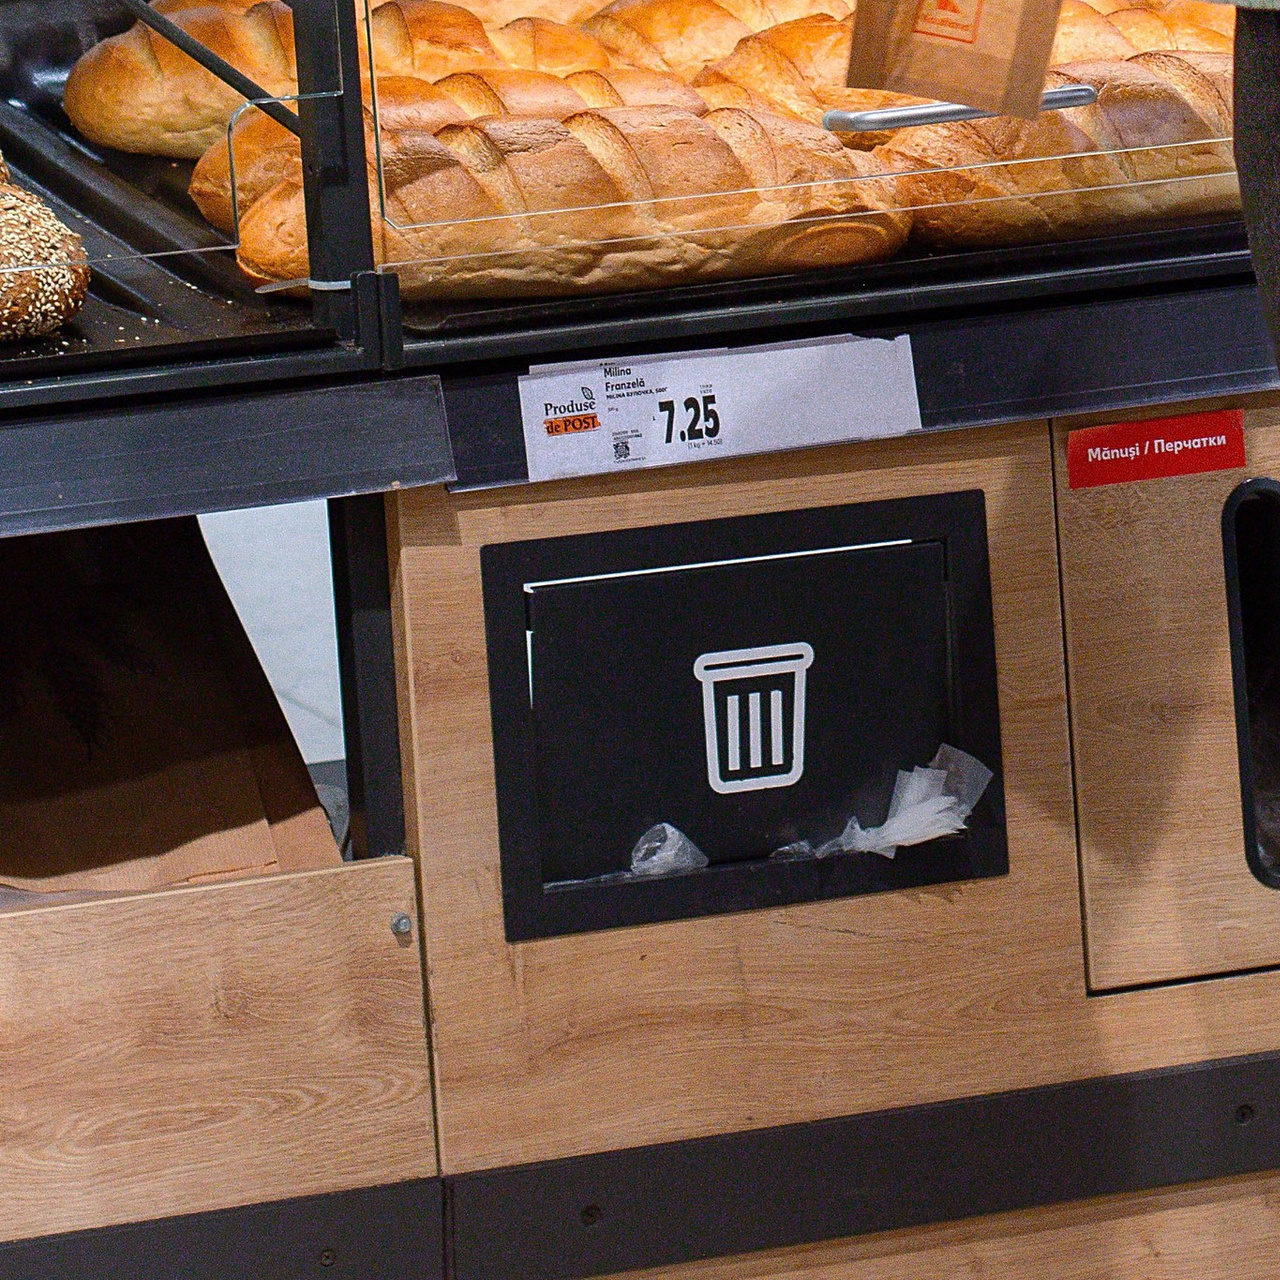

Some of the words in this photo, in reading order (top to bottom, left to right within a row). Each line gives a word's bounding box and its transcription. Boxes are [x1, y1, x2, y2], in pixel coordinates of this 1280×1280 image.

[604, 368, 631, 378] Milina
[605, 378, 645, 392] Franzelă
[545, 401, 596, 416] Produse
[546, 424, 560, 434] de
[564, 416, 597, 432] POST
[659, 395, 720, 444] 7.25
[1088, 443, 1140, 462] Mănuși
[1144, 441, 1149, 455] /
[1154, 435, 1226, 454] Перчатки
